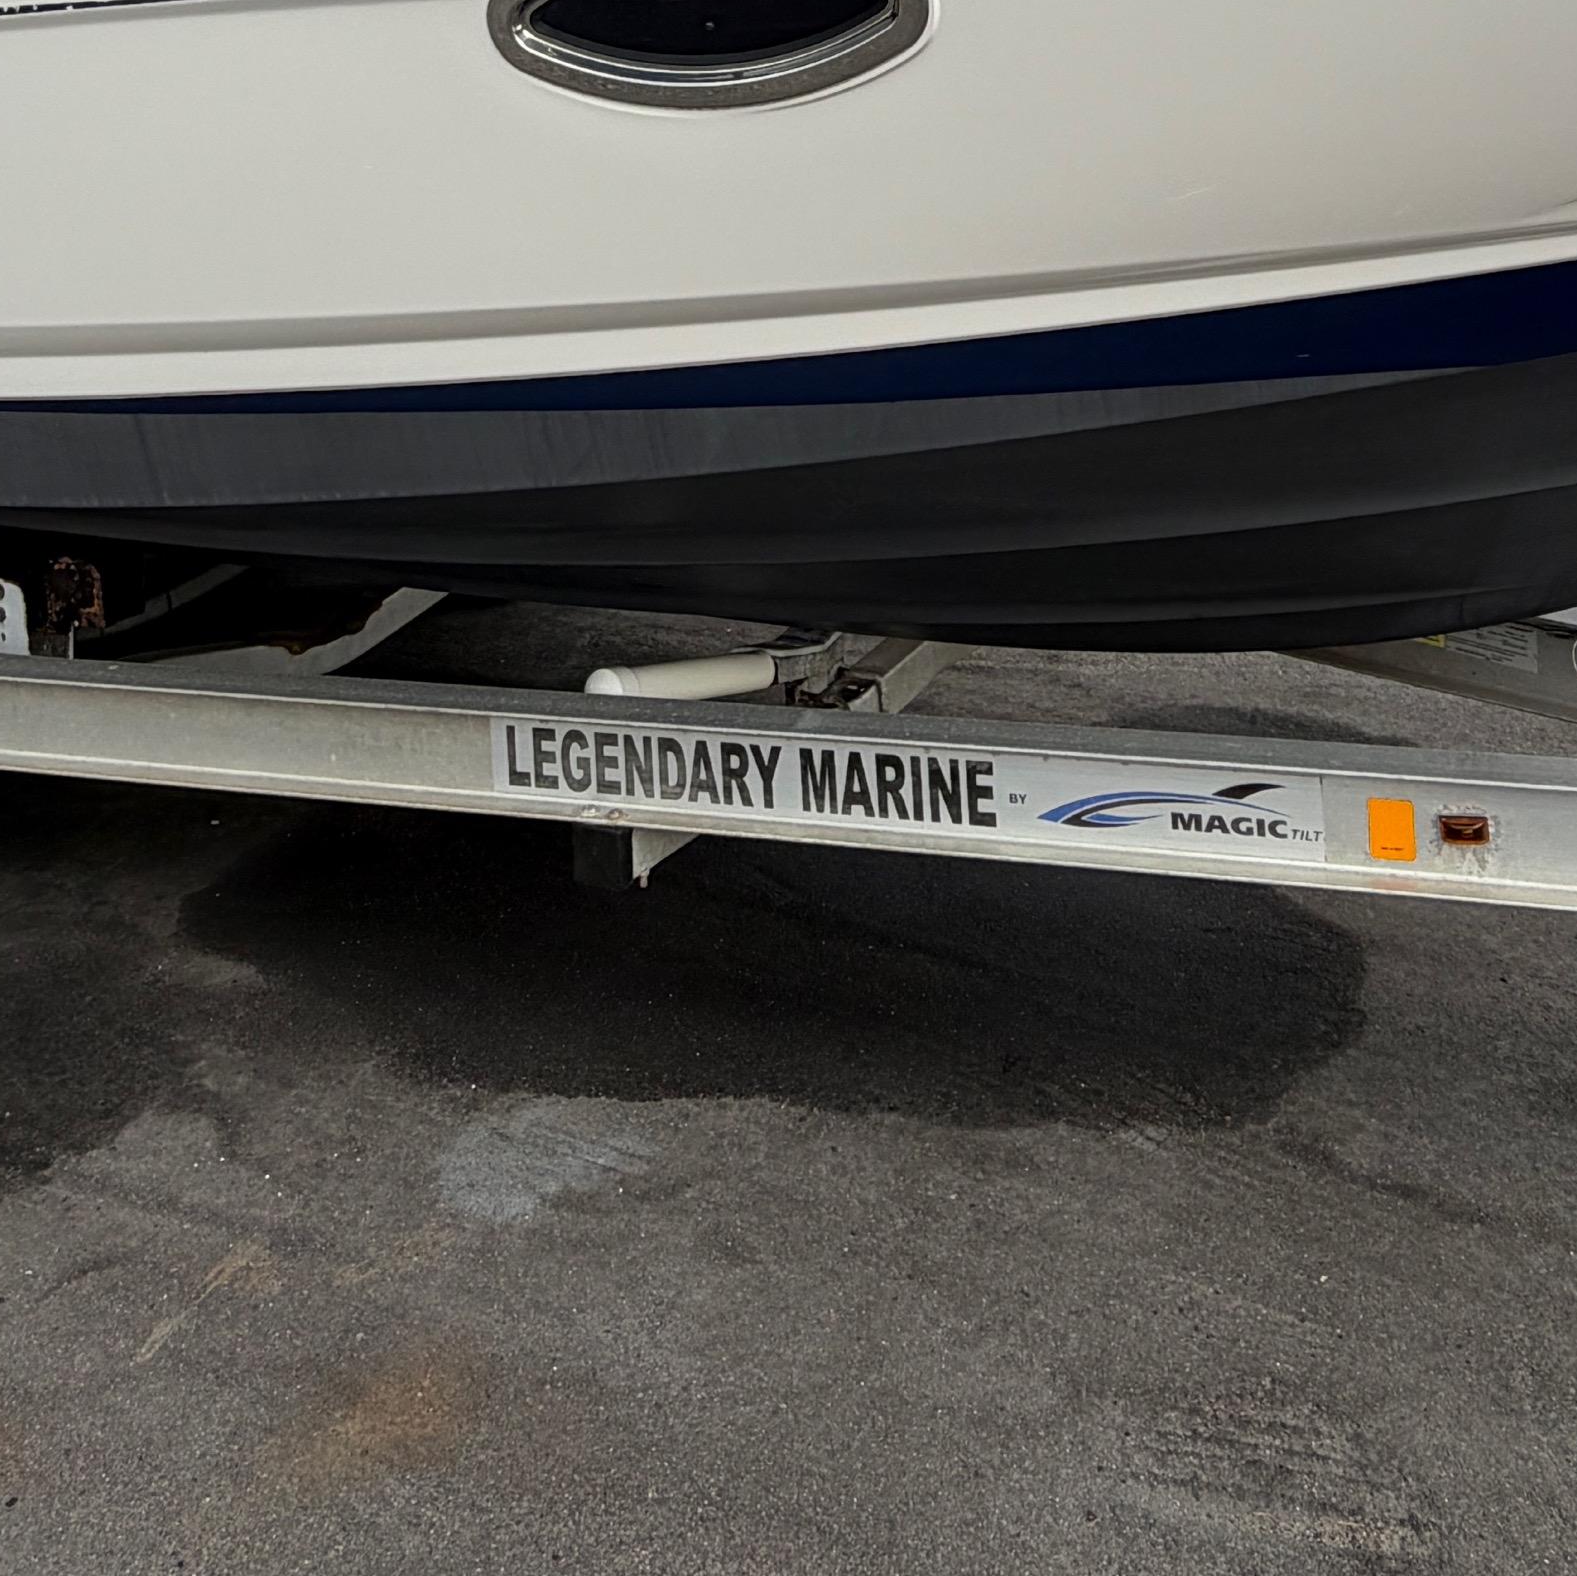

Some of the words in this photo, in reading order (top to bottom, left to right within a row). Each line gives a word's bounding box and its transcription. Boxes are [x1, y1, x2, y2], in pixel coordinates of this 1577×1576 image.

[506, 724, 782, 805] LEGENDARY
[800, 749, 998, 827] MARINE
[1009, 793, 1027, 804] BY
[1171, 812, 1288, 839] MAGIC
[1291, 829, 1323, 842] TILT
